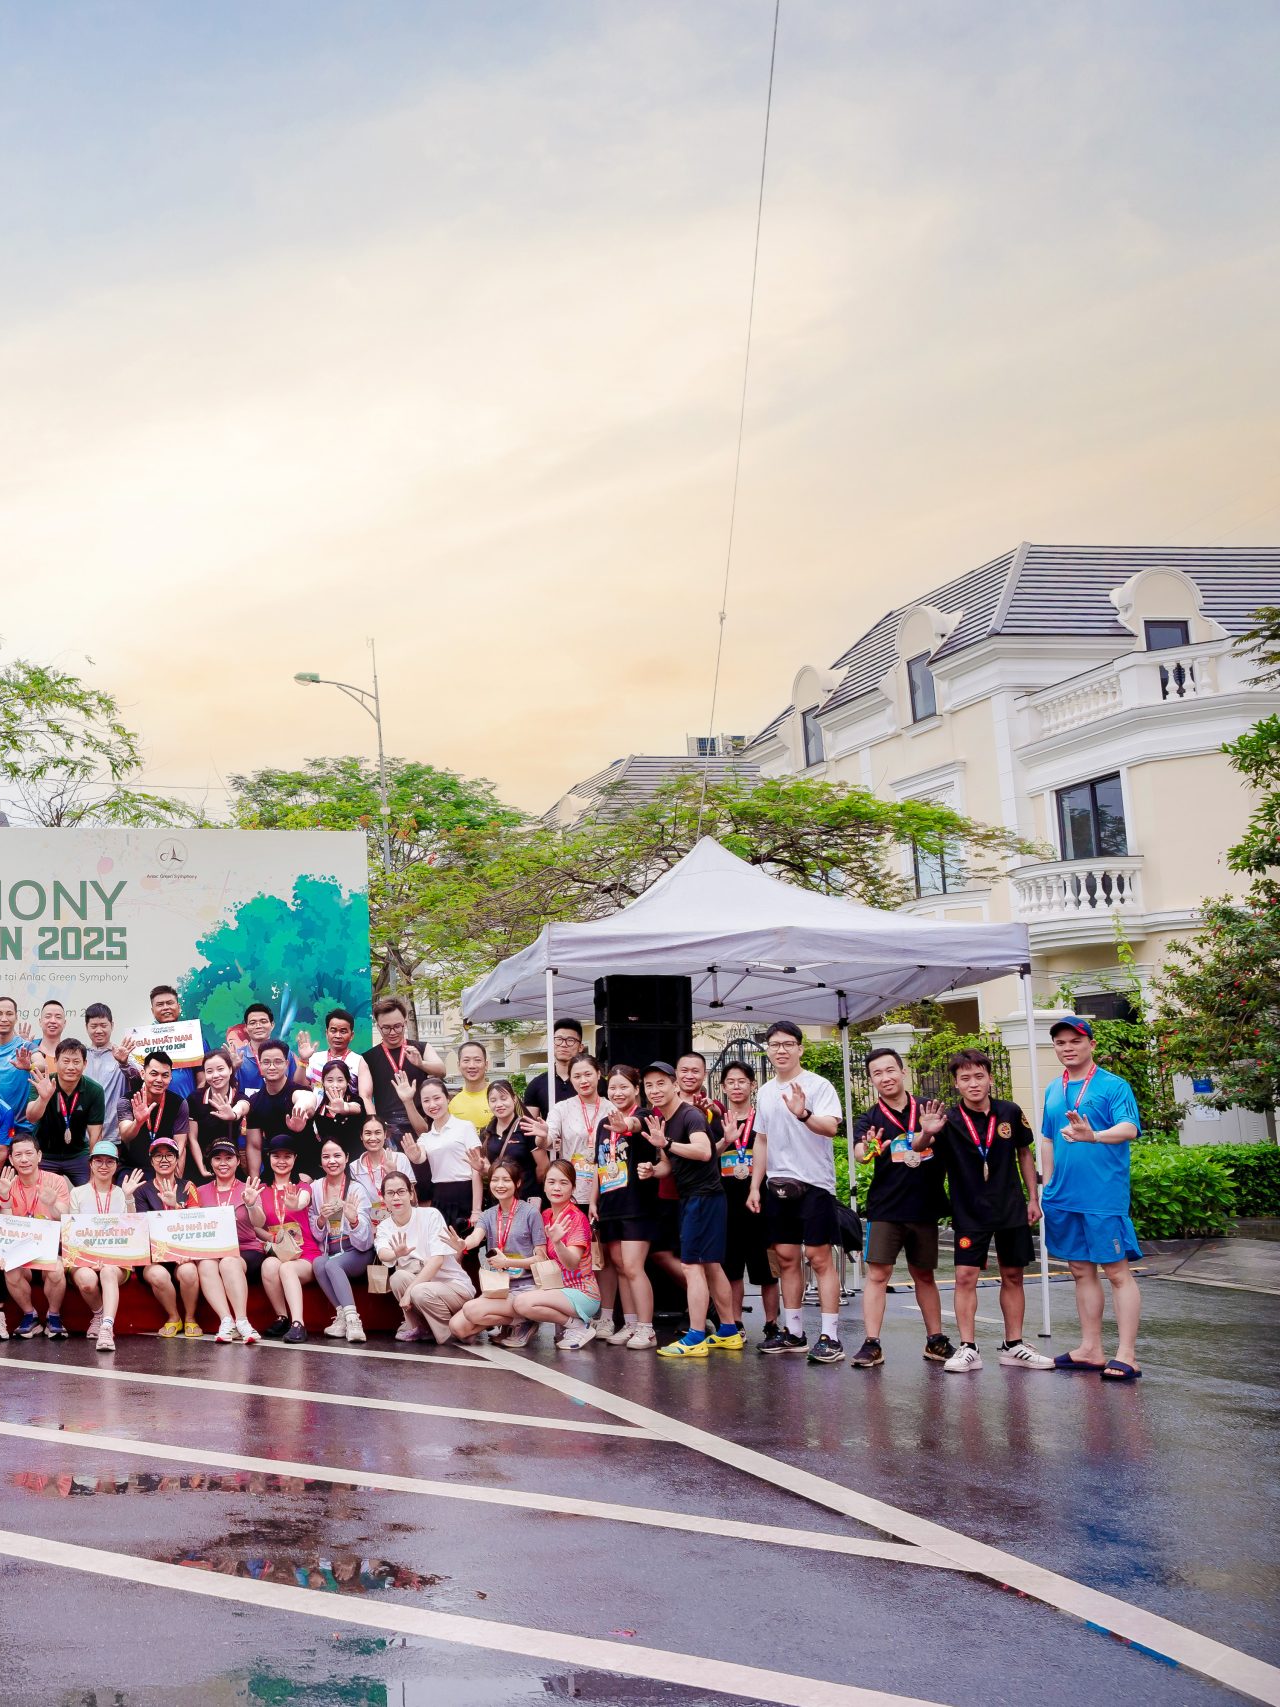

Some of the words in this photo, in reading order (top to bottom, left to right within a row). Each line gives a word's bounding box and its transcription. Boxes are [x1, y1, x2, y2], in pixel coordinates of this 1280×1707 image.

[37, 926, 127, 961] 2025
[19, 972, 46, 981] Anlac
[48, 972, 77, 981] Green
[79, 972, 129, 983] Symphony
[167, 1222, 185, 1232] GIẢI
[8, 1230, 20, 1238] BA
[171, 1232, 184, 1241] CỰ
